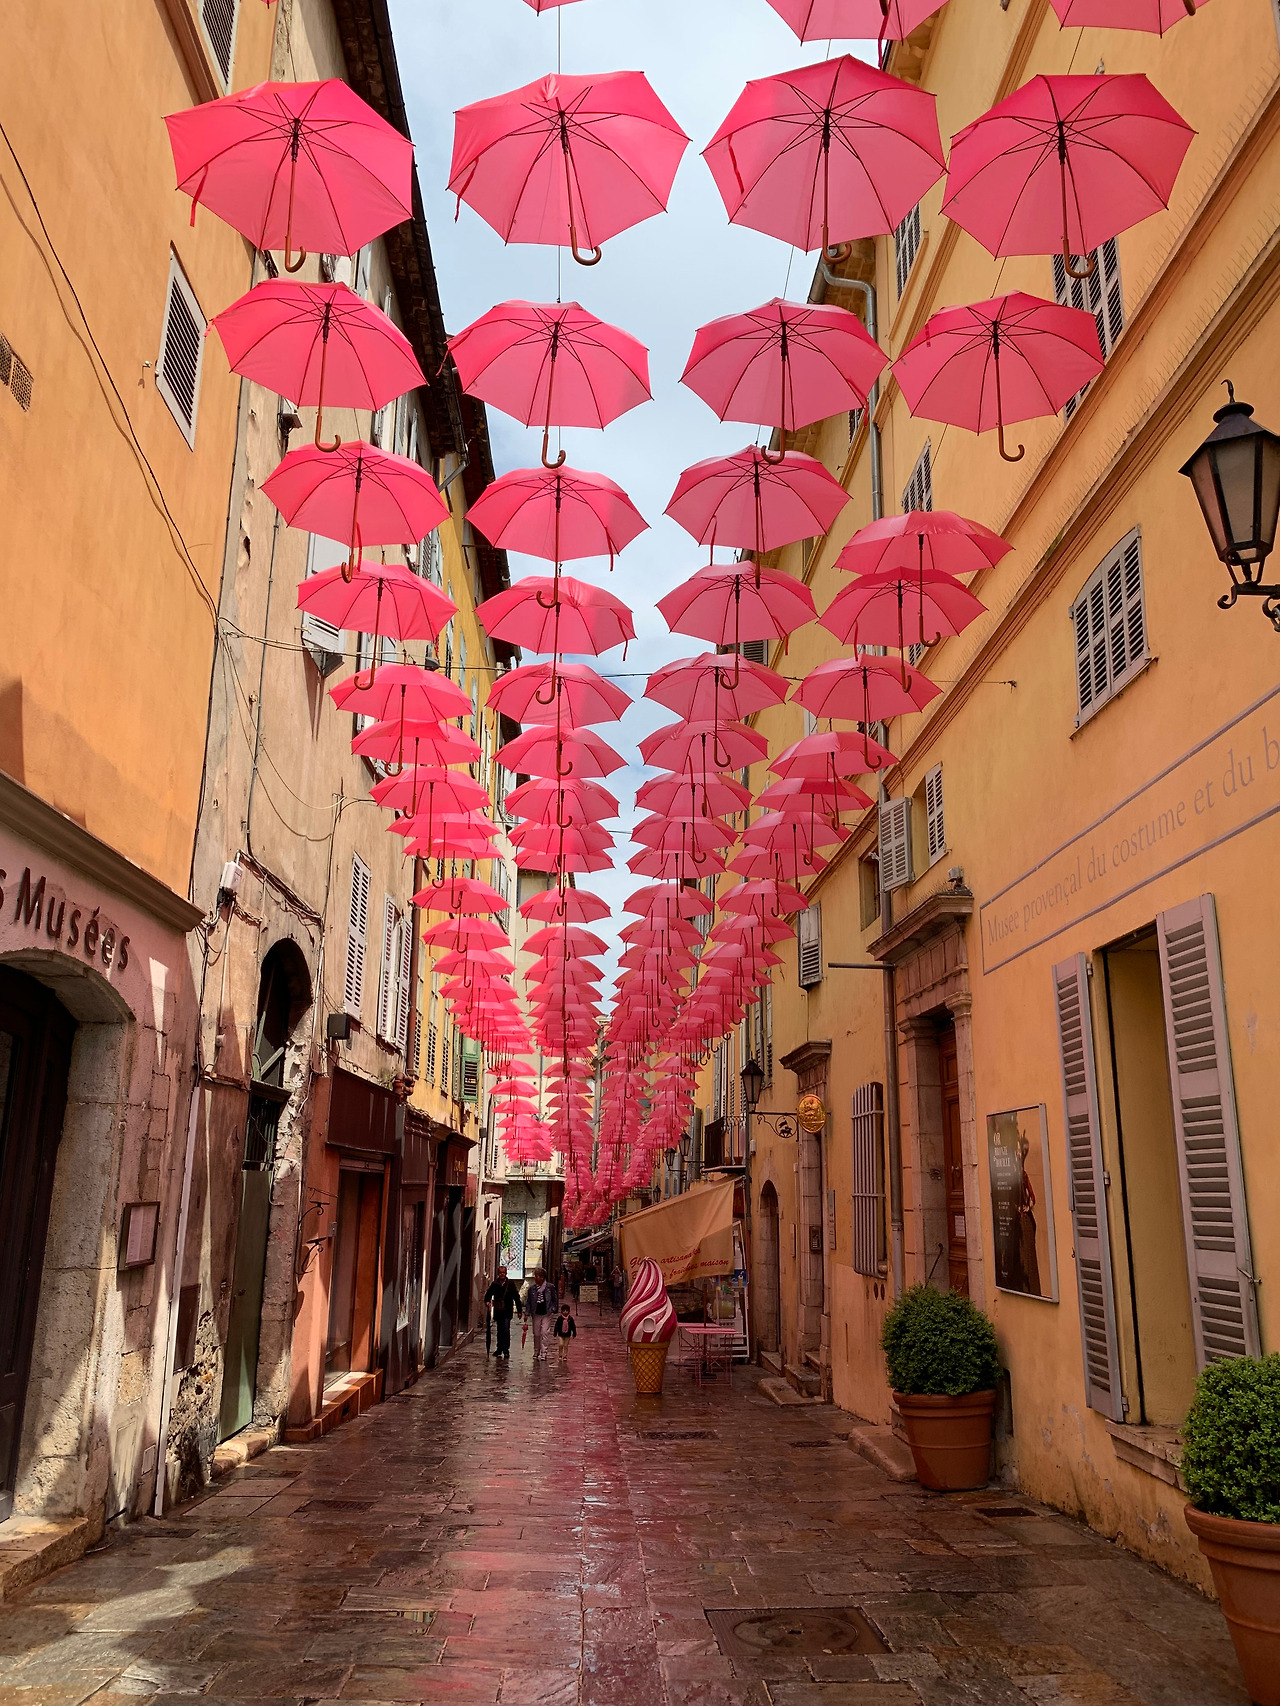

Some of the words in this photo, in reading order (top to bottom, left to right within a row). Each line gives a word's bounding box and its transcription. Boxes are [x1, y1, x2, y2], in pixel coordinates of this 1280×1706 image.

[1023, 856, 1082, 932] provençal
[1086, 845, 1107, 883] du
[1111, 801, 1187, 868] costume
[1193, 780, 1216, 816] et
[1222, 748, 1255, 798] du
[14, 867, 131, 970] Musées
[700, 1259, 729, 1267] maison
